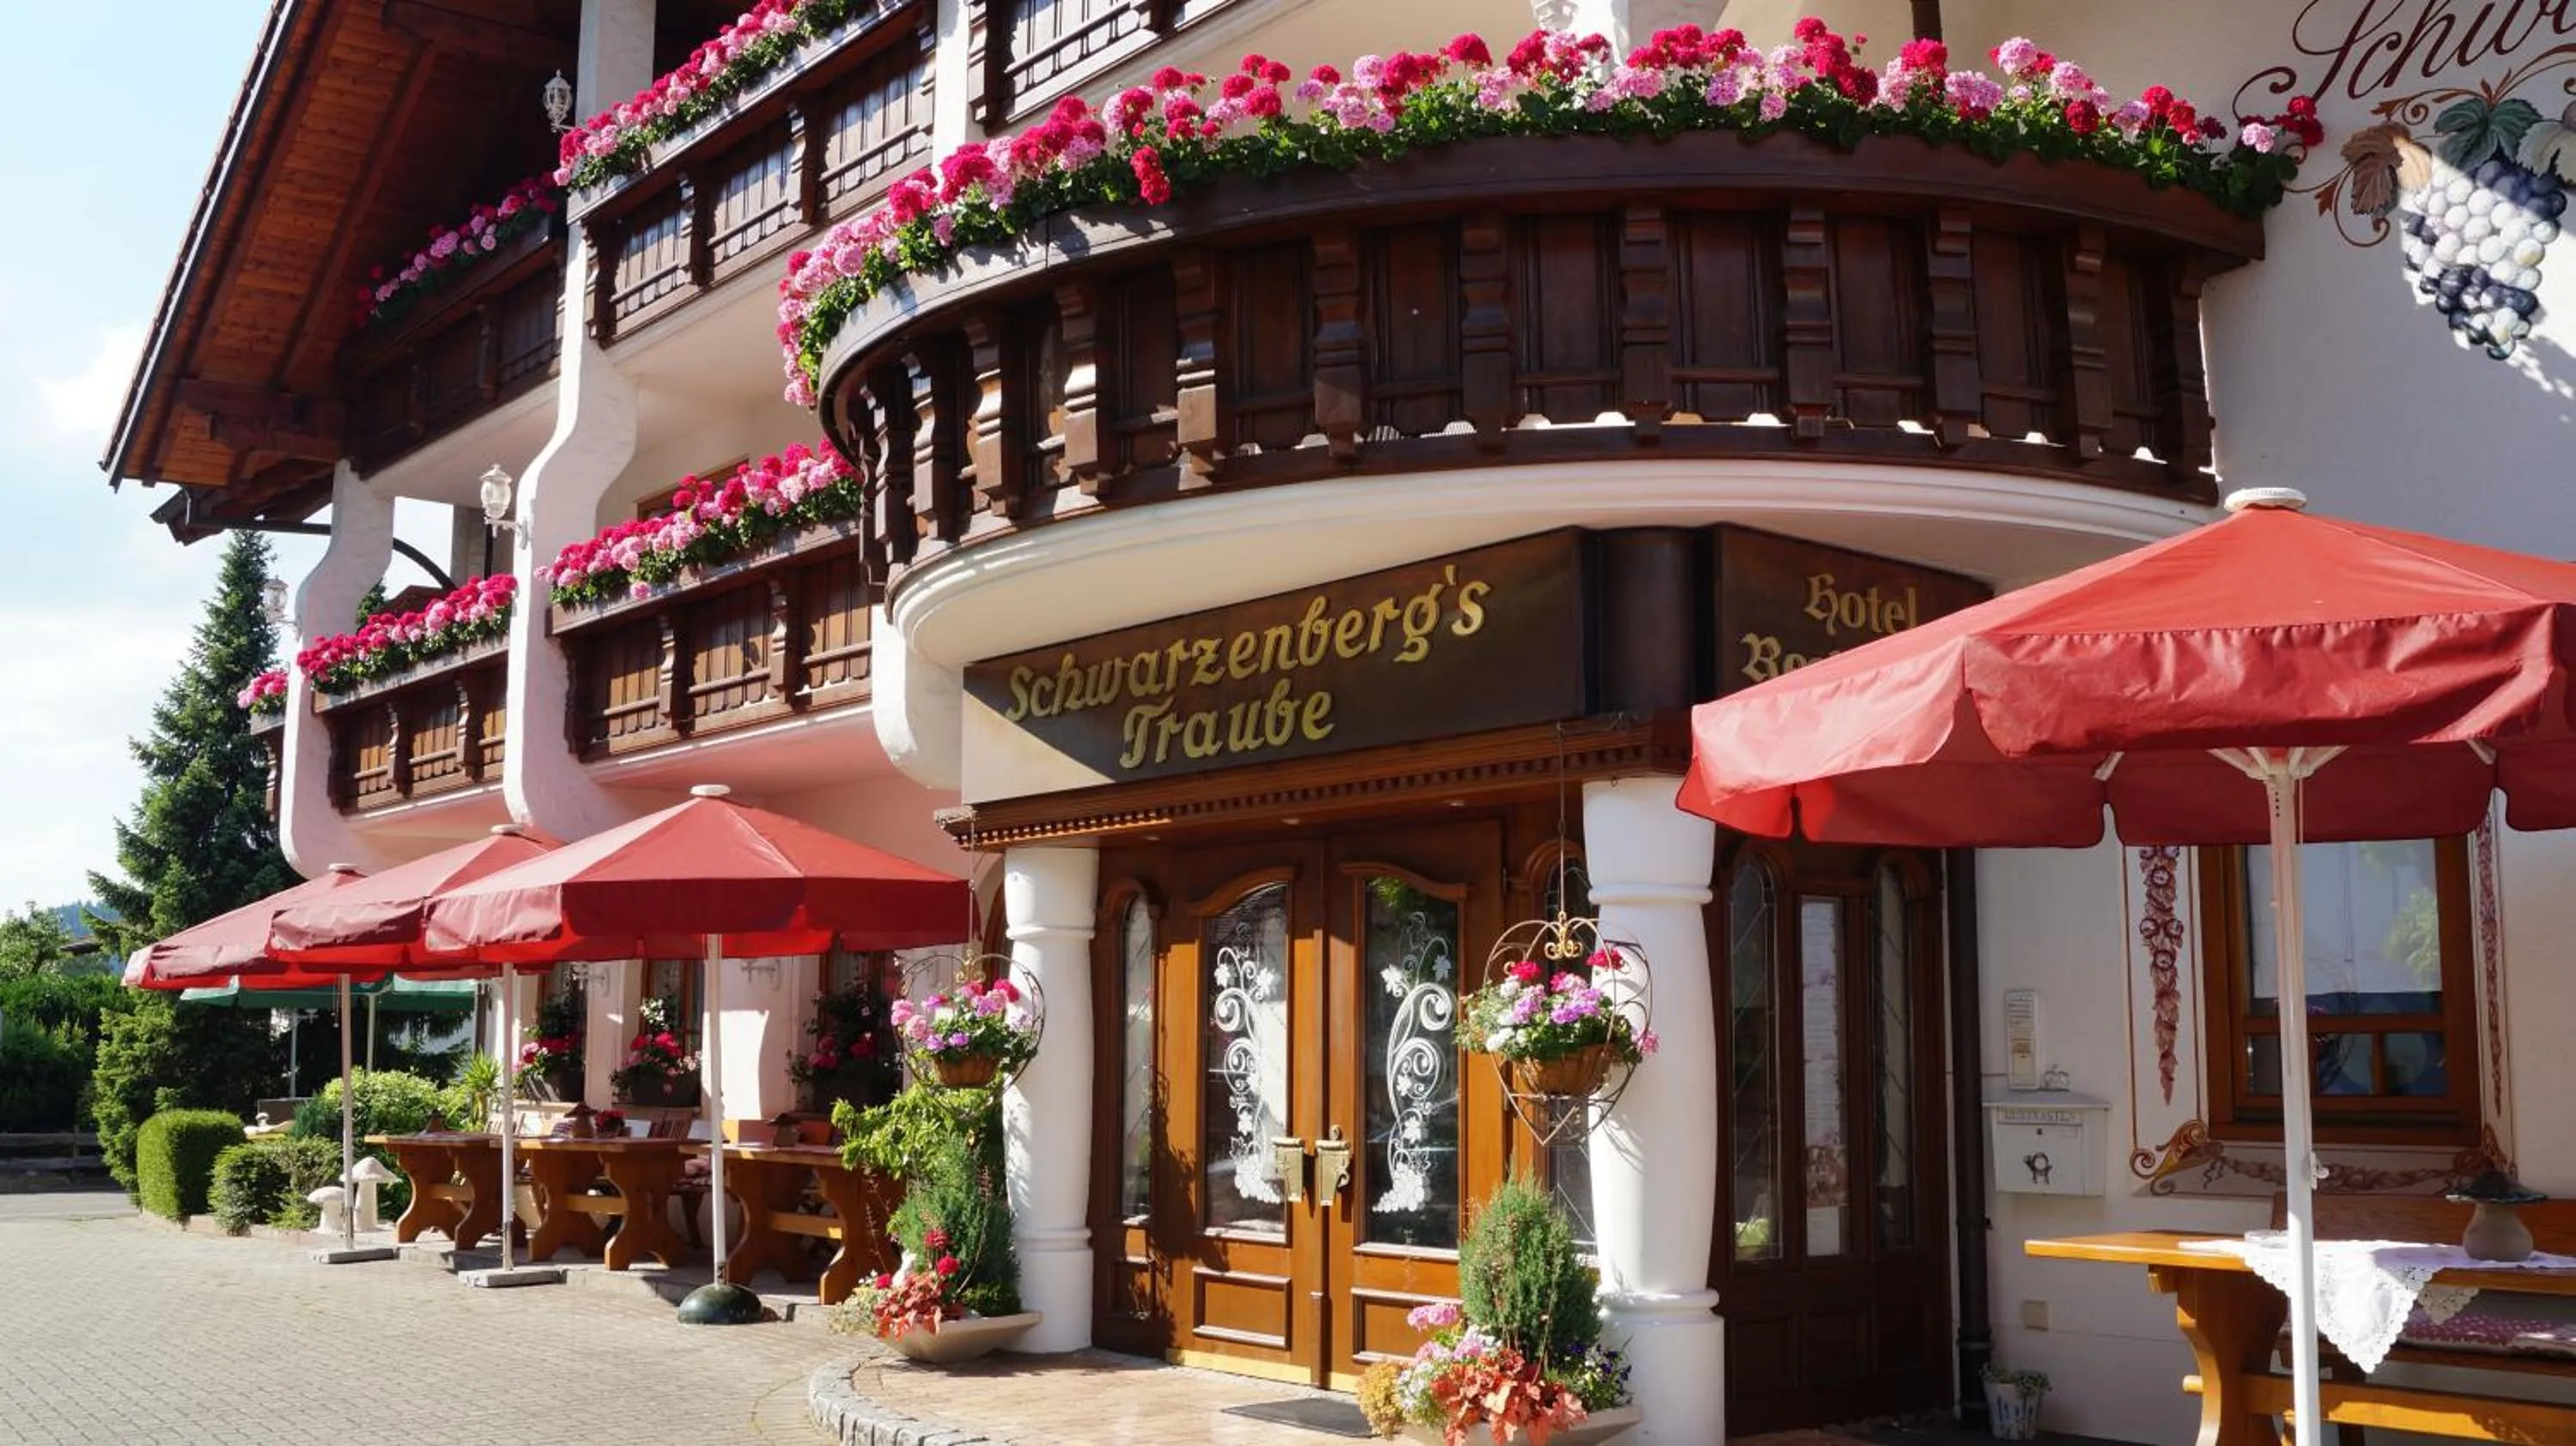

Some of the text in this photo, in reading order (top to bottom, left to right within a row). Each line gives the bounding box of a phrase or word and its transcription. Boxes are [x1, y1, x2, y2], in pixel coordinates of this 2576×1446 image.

[2233, 0, 2576, 122] Schw
[1006, 564, 1491, 722] Schwarzenberg's
[1804, 574, 1917, 635] Hotel
[1119, 678, 1335, 769] Traube
